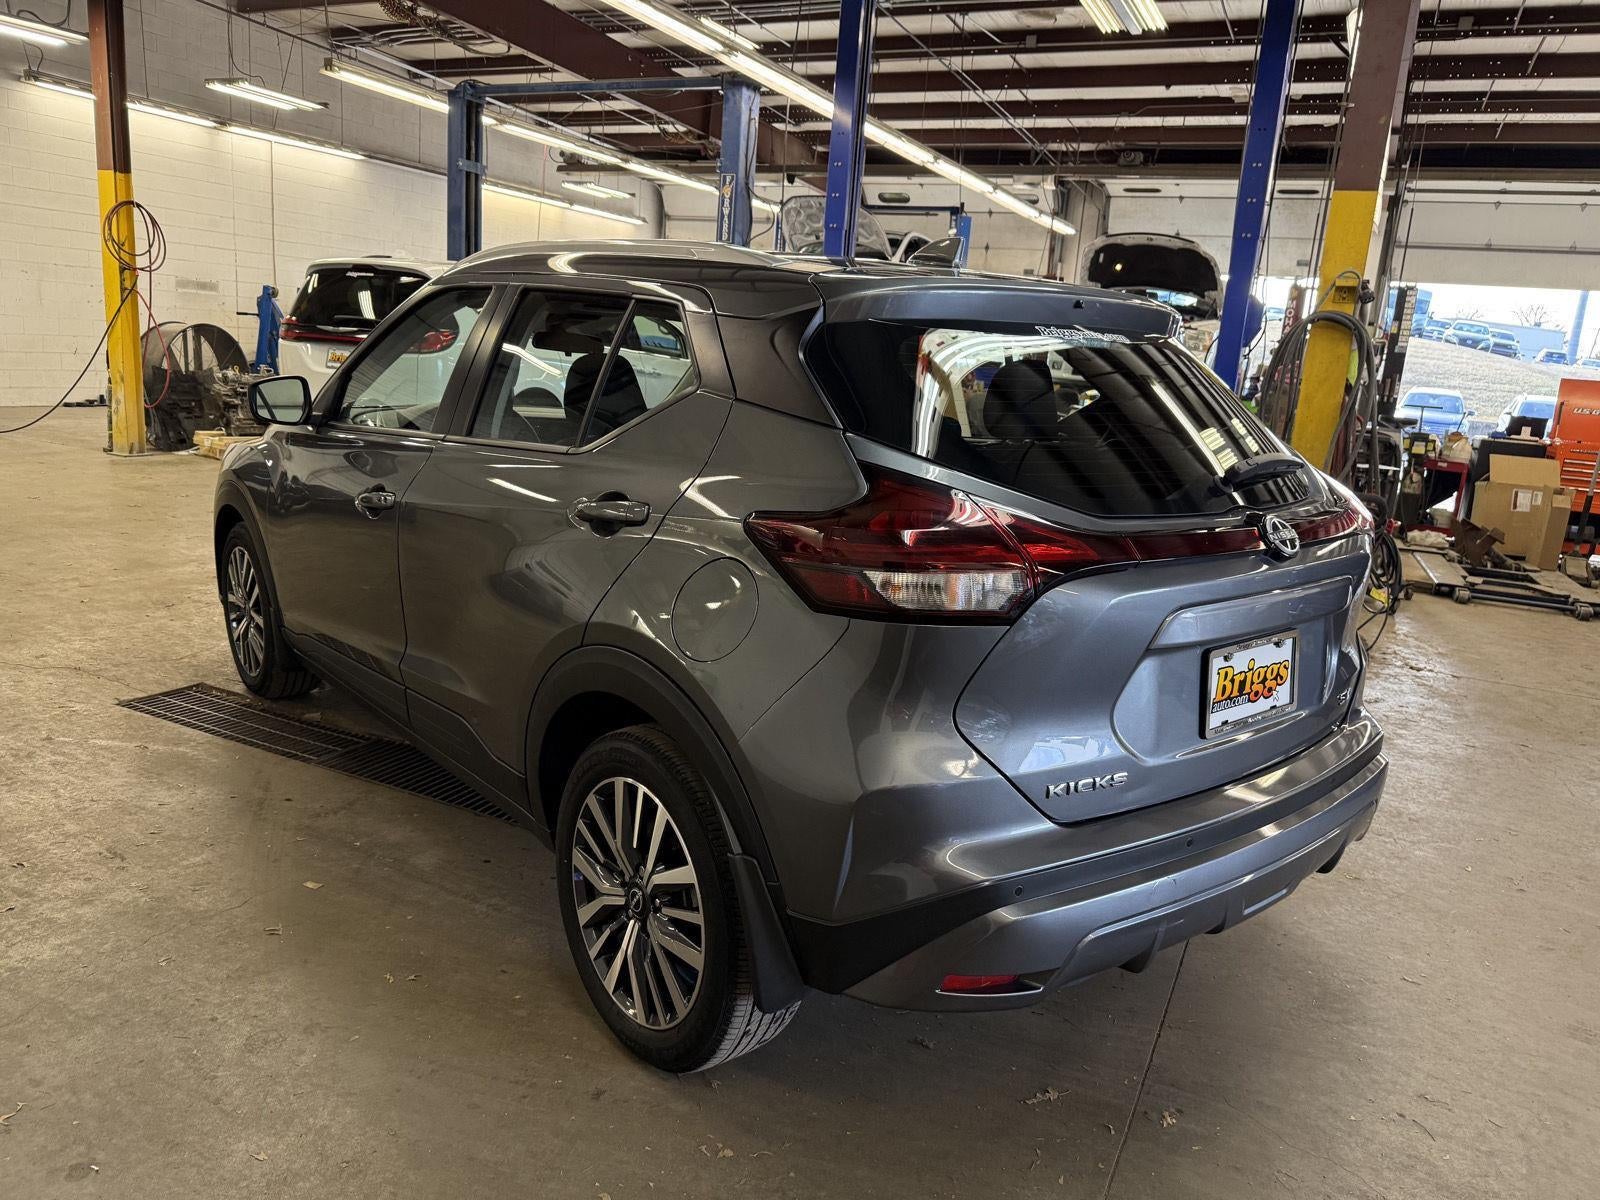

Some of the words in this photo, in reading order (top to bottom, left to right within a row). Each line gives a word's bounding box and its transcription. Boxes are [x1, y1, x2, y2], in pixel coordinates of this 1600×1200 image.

[721, 175, 733, 241] FORWARD
[1213, 658, 1290, 703] Briggs
[1211, 693, 1250, 713] auto.com
[1045, 771, 1128, 799] KICKS
